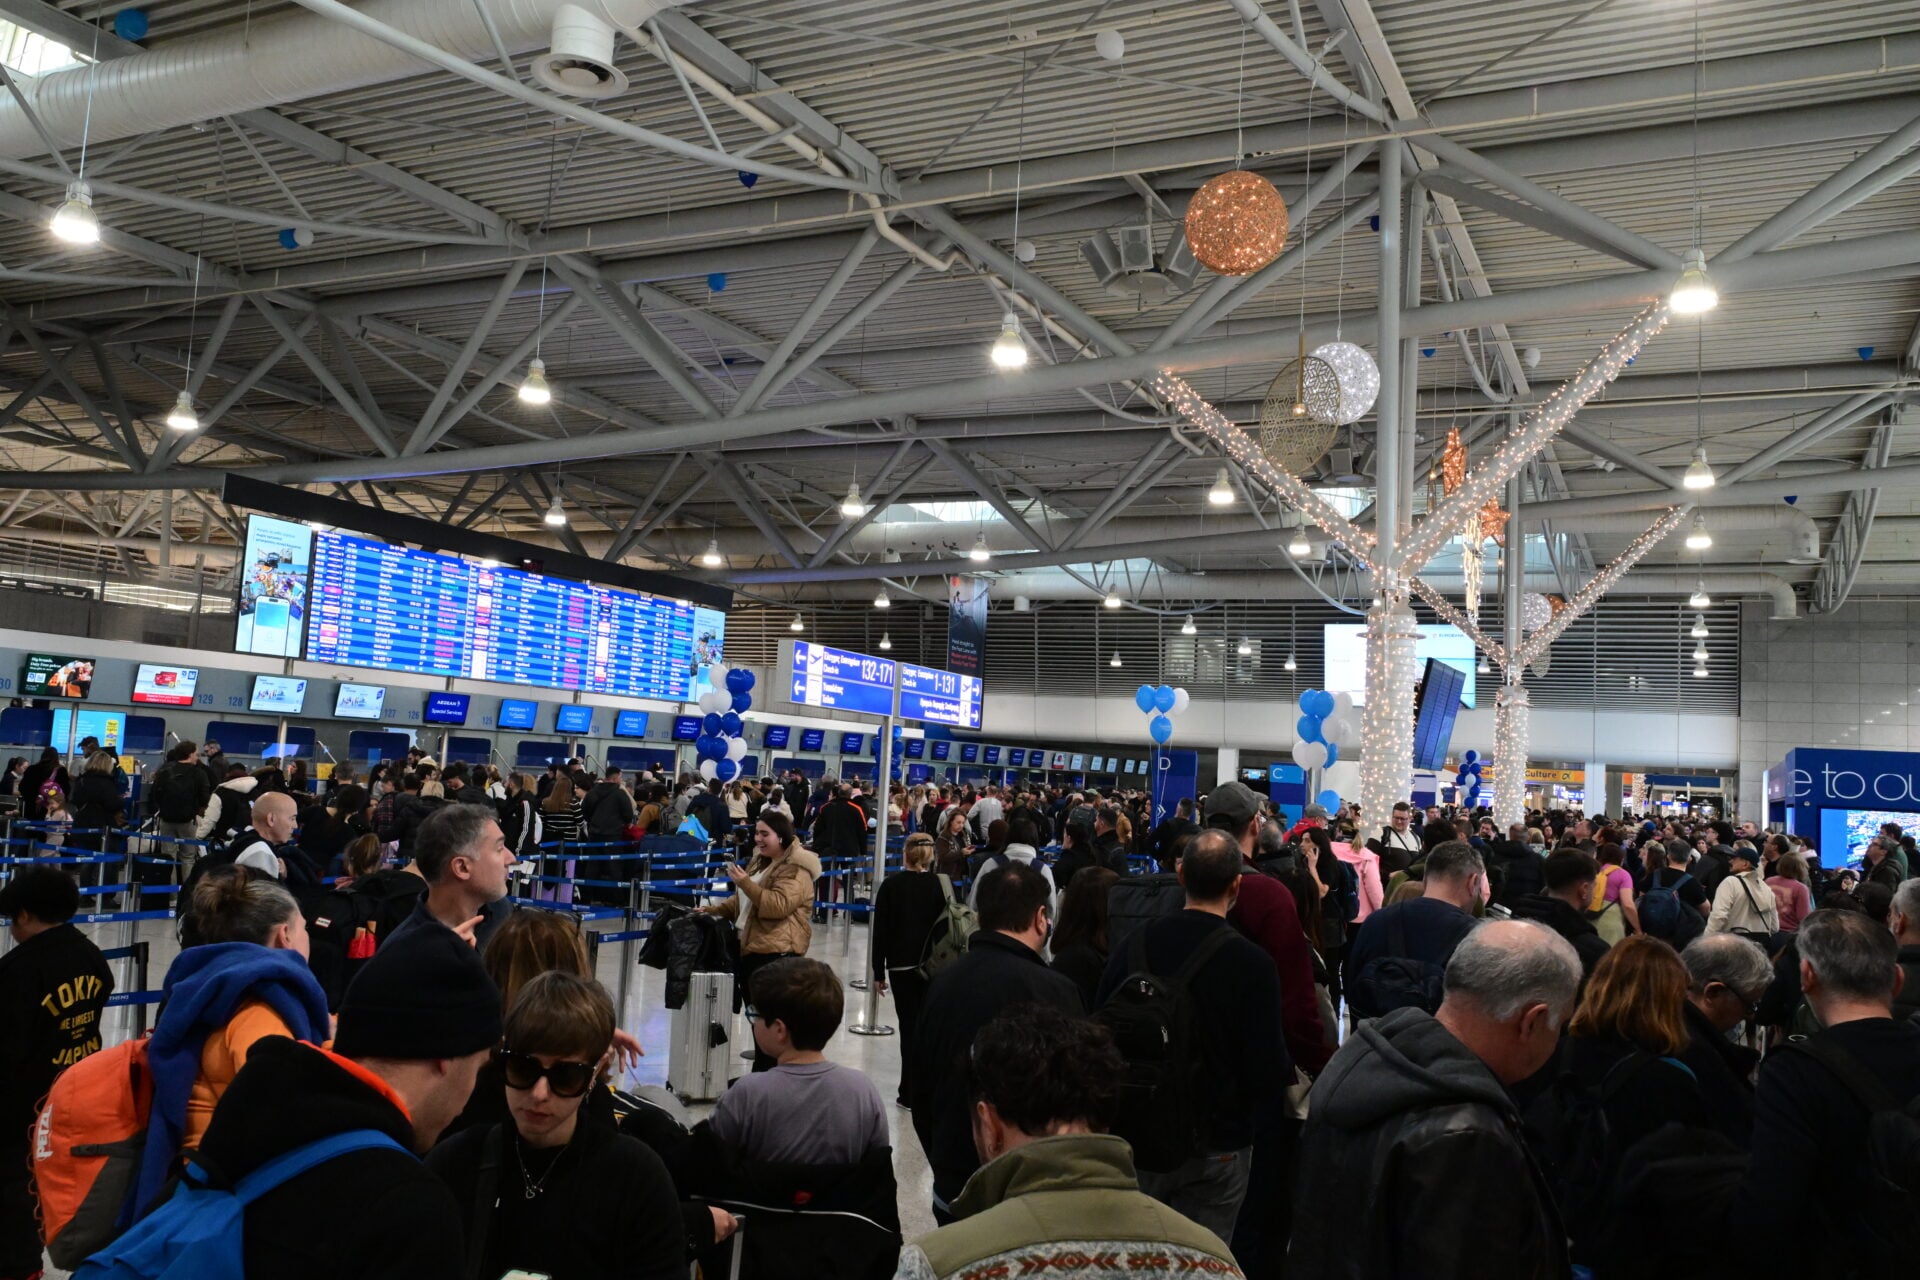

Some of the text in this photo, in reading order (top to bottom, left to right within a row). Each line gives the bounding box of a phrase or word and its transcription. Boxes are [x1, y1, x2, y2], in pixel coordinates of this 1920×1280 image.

[862, 660, 893, 684] 132-171
[935, 673, 955, 694] 1-131
[199, 694, 213, 705] 129
[228, 697, 243, 707] 128
[385, 709, 396, 719] 127
[1159, 757, 1171, 770] D
[1272, 767, 1284, 779] C
[1525, 770, 1557, 778] Culture
[1821, 762, 1866, 799] to
[52, 1036, 99, 1065] JAPAN
[36, 1103, 54, 1158] PETZL
